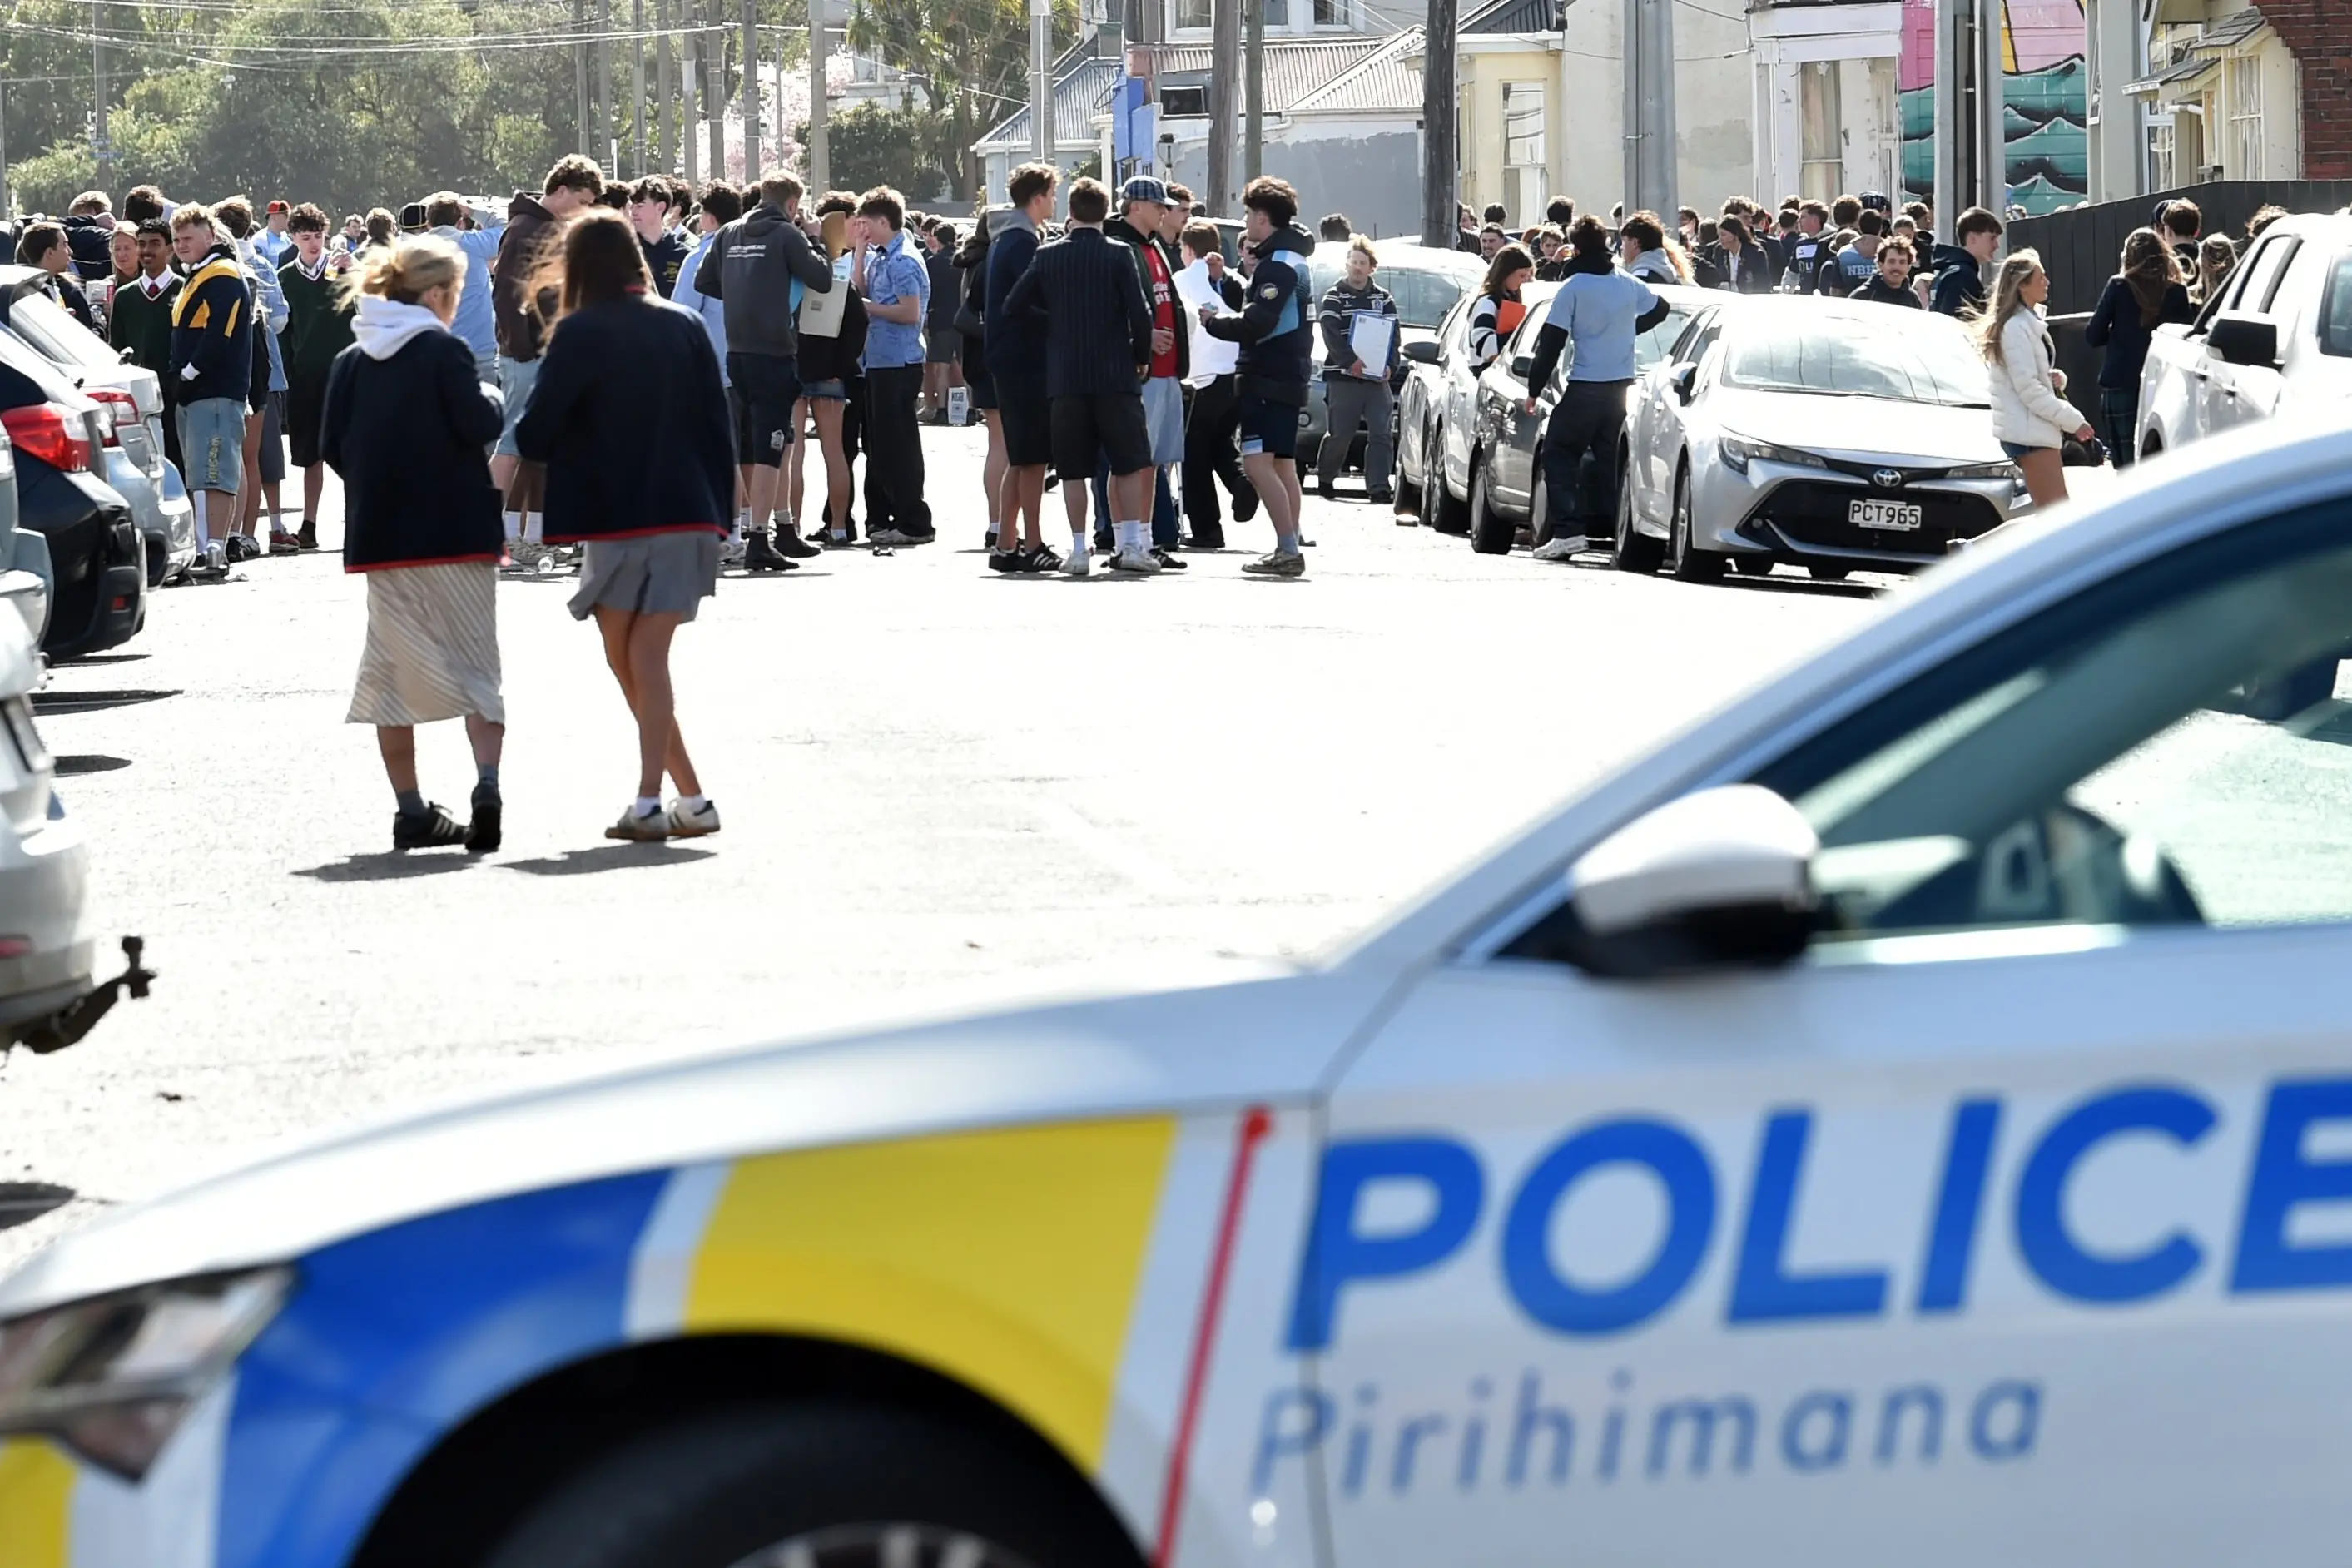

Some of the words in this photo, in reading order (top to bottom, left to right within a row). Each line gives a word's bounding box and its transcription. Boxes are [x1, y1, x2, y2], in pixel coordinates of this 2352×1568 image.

[1851, 503, 1919, 526] PCT965
[1283, 1077, 2352, 1354] POLICE
[1247, 1365, 2047, 1496] Pirihimana
